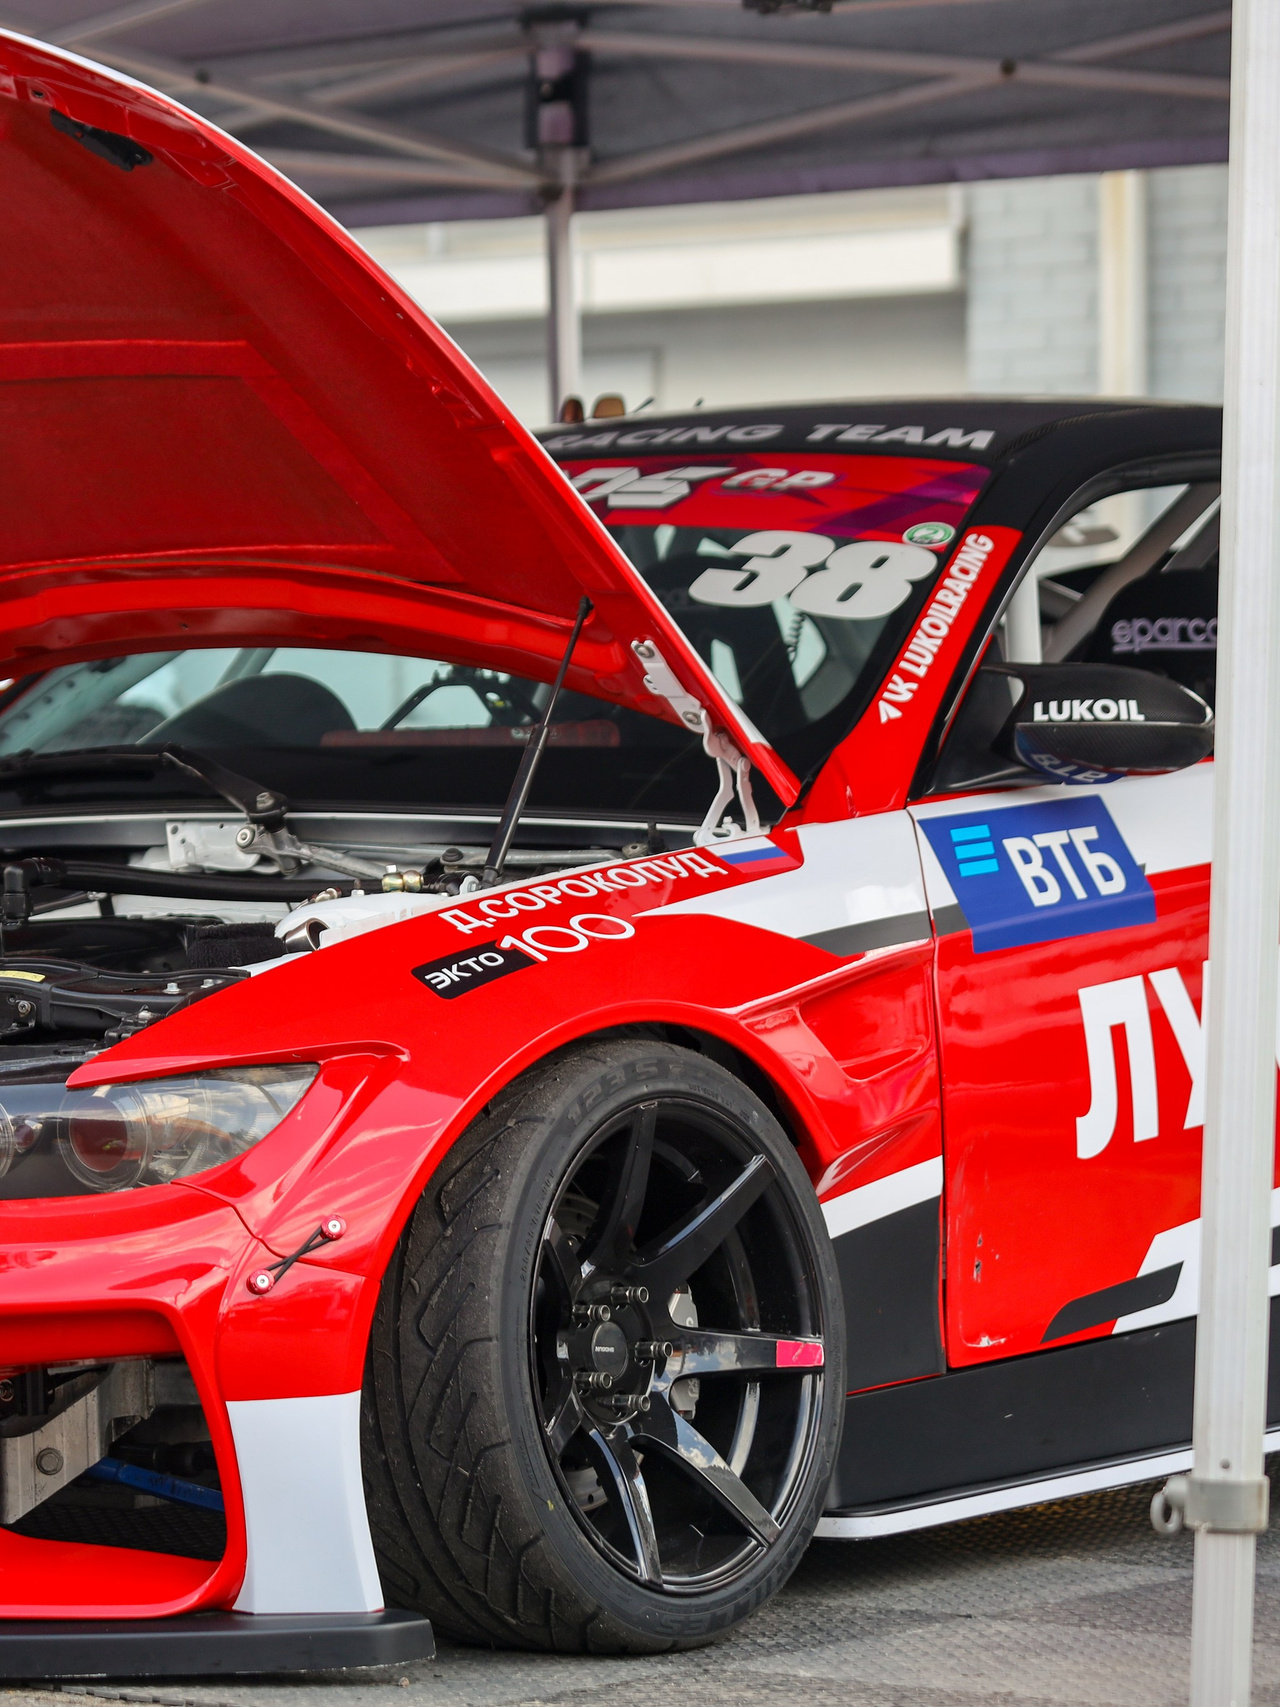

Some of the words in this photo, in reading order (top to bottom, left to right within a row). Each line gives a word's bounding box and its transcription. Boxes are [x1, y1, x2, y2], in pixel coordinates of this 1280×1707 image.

[804, 424, 996, 450] TEAM
[721, 468, 836, 491] GP
[688, 530, 938, 620] 38
[897, 533, 995, 679] LUKOILRACING
[1032, 699, 1146, 722] LUKOIL
[1002, 826, 1126, 907] ВТБ
[438, 851, 728, 934] Д.СОРОКОПУД
[500, 913, 635, 962] 100
[424, 950, 505, 990] ЭКТО
